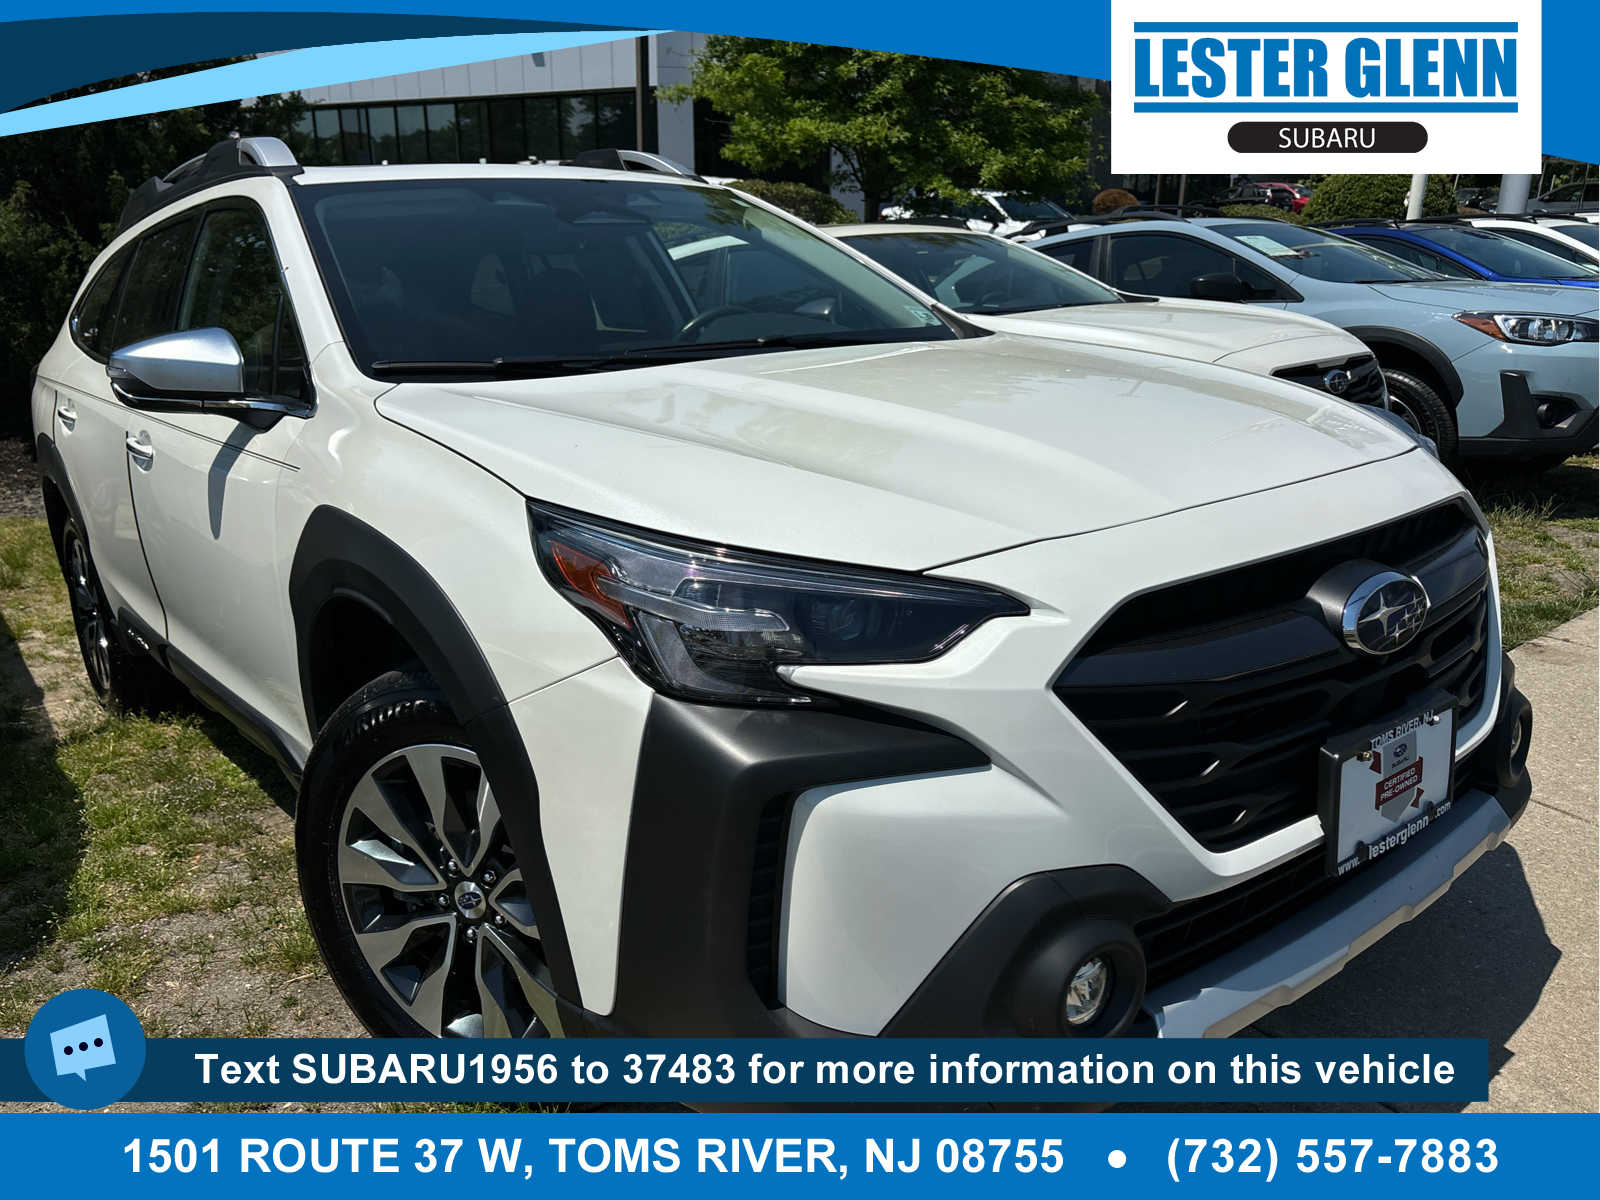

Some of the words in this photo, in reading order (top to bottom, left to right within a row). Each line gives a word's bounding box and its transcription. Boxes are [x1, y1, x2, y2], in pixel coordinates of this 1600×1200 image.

[1371, 729, 1394, 750] TOMS
[1380, 775, 1418, 801] PRE-OWNED
[1384, 767, 1416, 790] CERTIFIED
